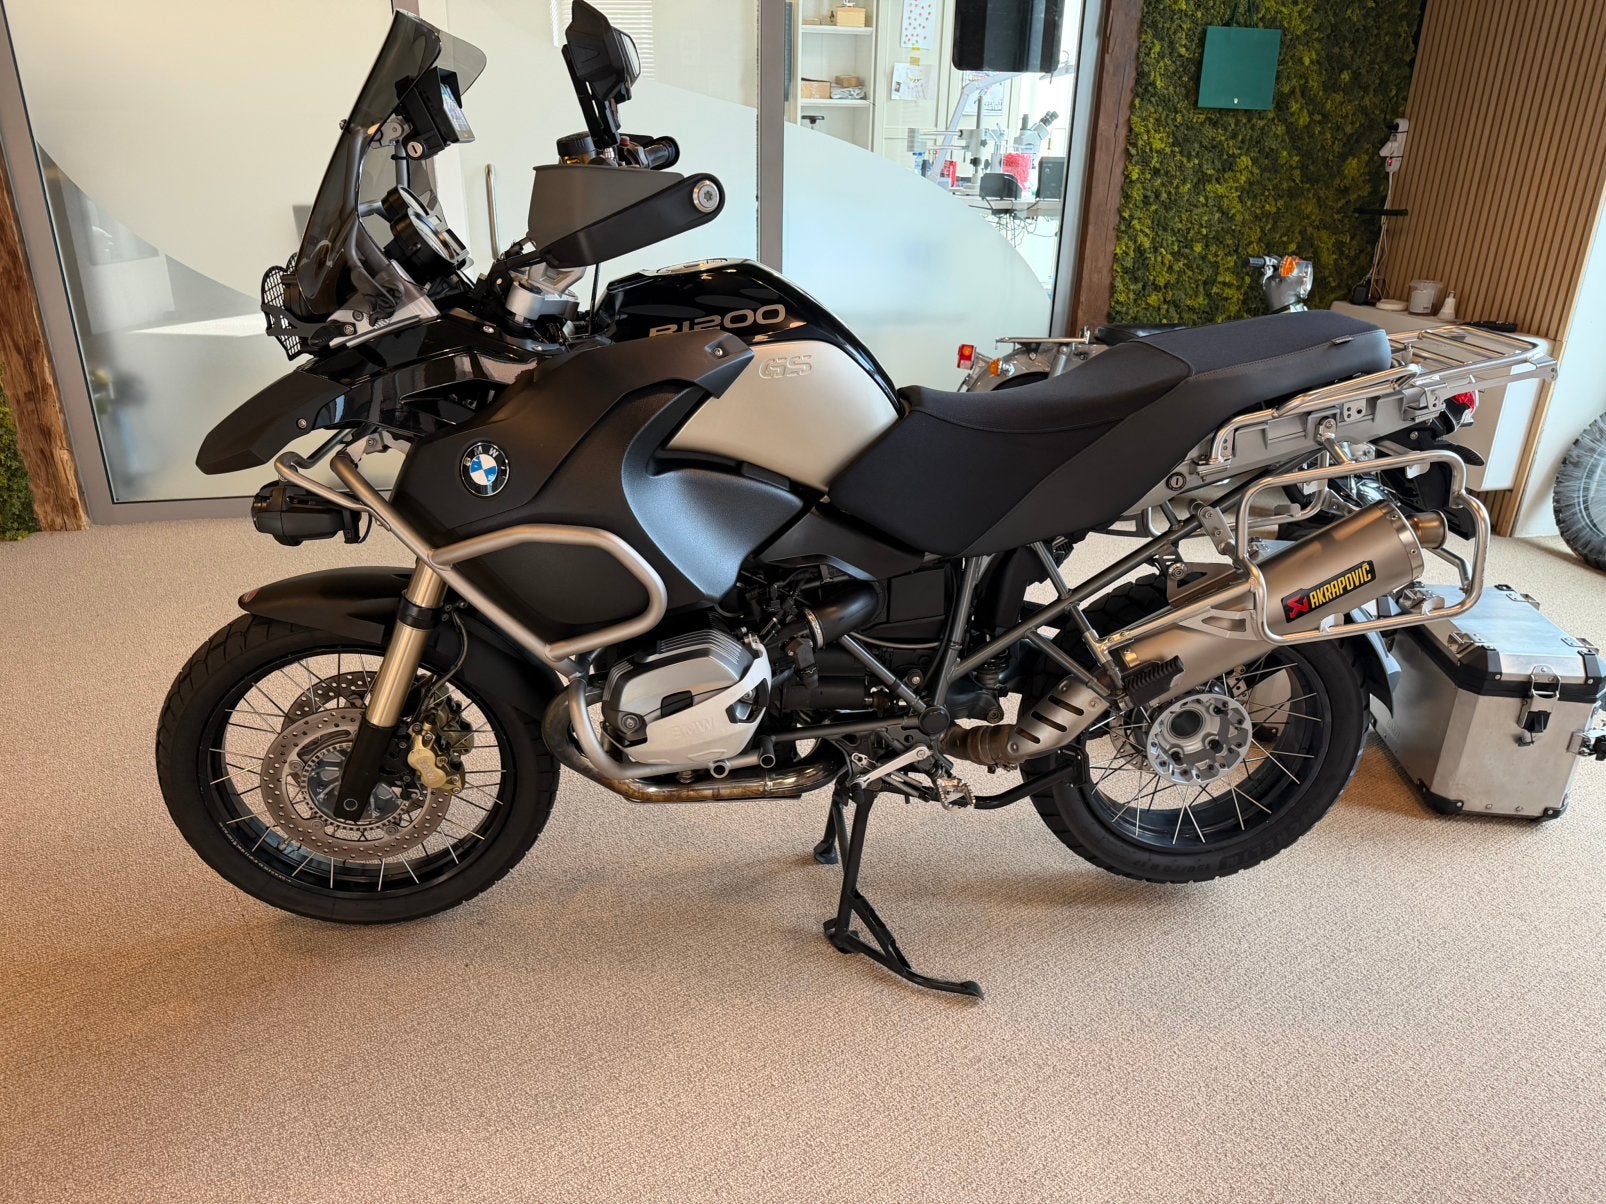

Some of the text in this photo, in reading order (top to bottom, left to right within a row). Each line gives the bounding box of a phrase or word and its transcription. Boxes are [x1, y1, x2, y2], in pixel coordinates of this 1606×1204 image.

[649, 304, 786, 337] R1200
[758, 354, 813, 380] GS
[464, 445, 499, 467] BMW
